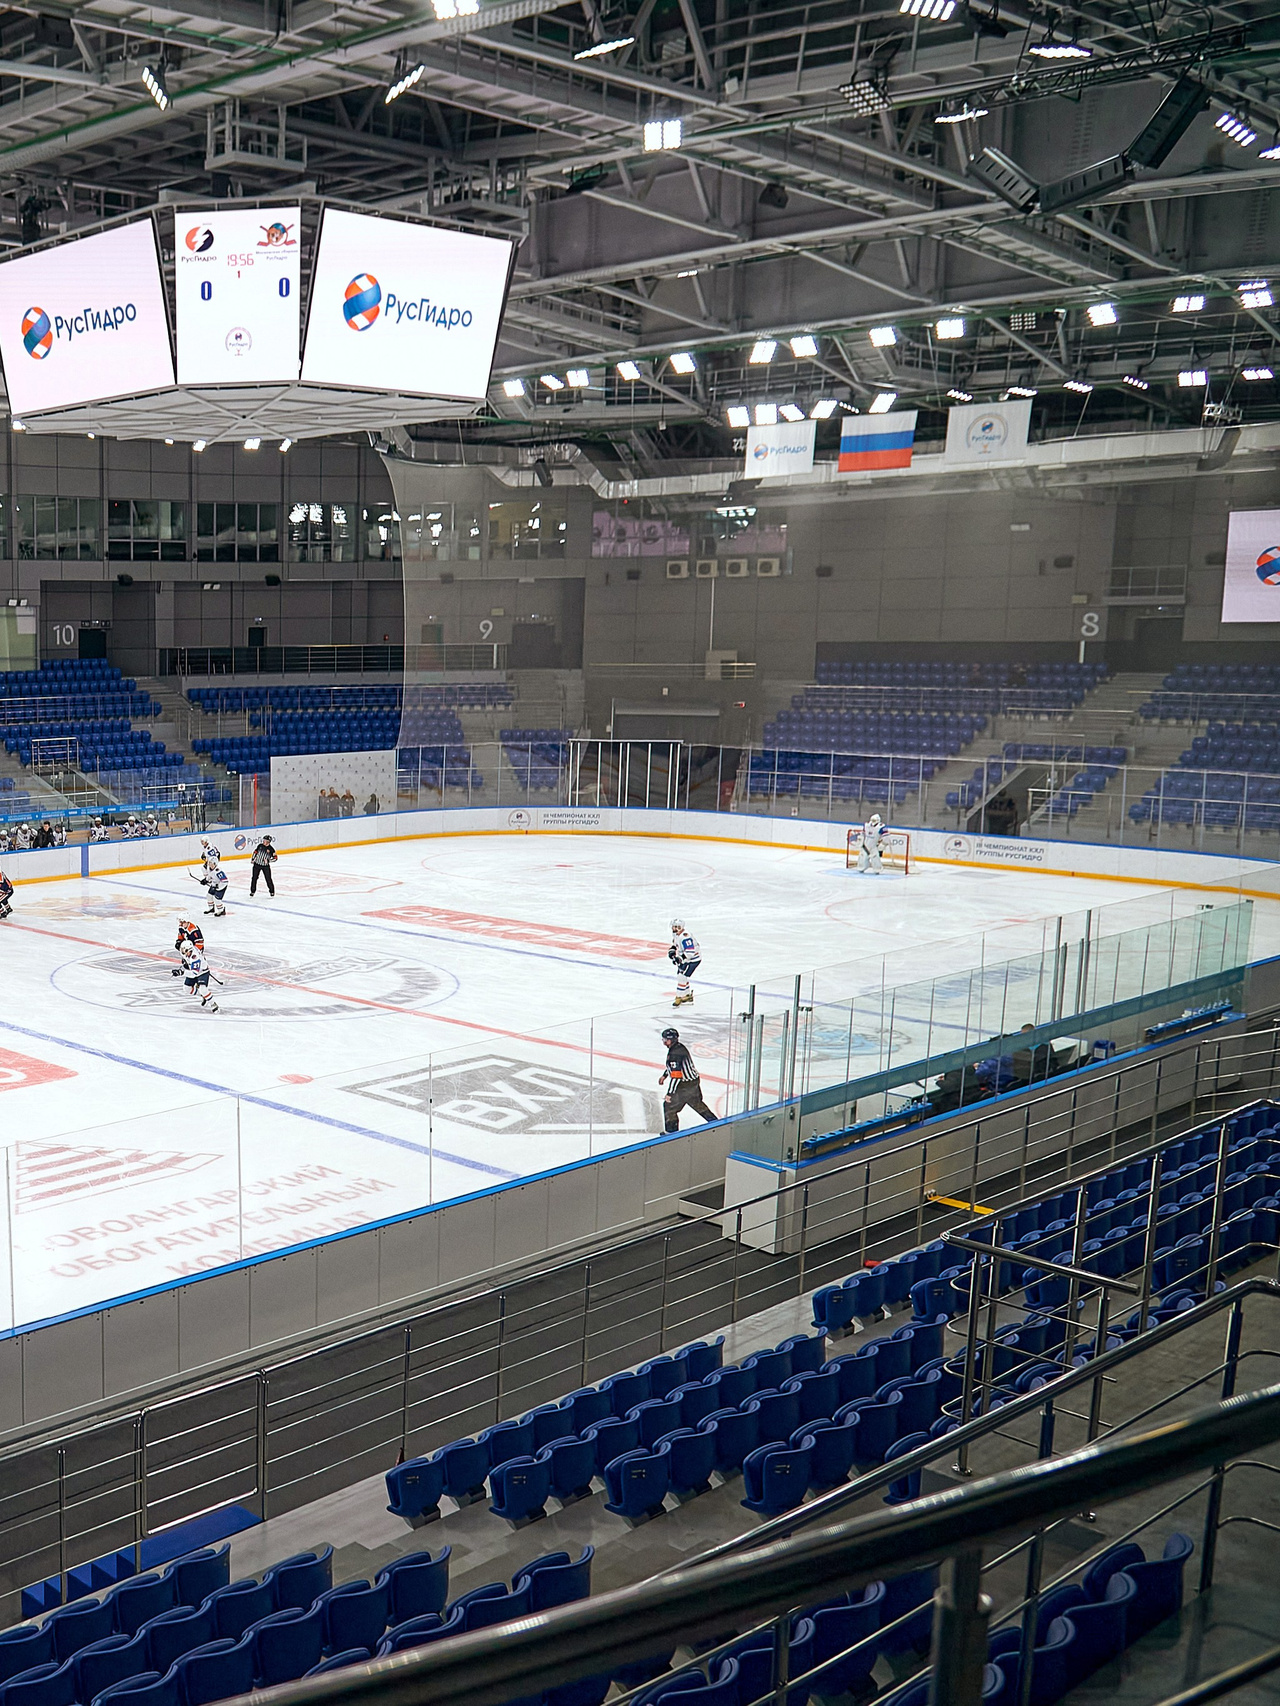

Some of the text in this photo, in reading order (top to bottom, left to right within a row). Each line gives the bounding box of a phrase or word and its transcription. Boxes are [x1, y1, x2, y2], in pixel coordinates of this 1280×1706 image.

[201, 281, 212, 301] 0
[279, 277, 290, 297] 0
[55, 303, 136, 341] РусГидро
[385, 293, 472, 330] РусГидро
[770, 445, 808, 456] РусГидро
[53, 624, 74, 646] 10
[479, 619, 493, 640] 9
[1081, 612, 1099, 637] 8
[247, 836, 277, 846] РусГо
[984, 844, 1028, 852] ЧЕМПИОНАТ
[976, 850, 1043, 861] ГРУППЫ РУСГИДРО
[433, 1066, 600, 1131] ВХЛ
[46, 1162, 343, 1250] ОВОАНГАРСКИЙ
[49, 1176, 397, 1278] ОБОГАТИТЕЛЬНЫЙ
[166, 1209, 376, 1277] КОМБИНАТ
